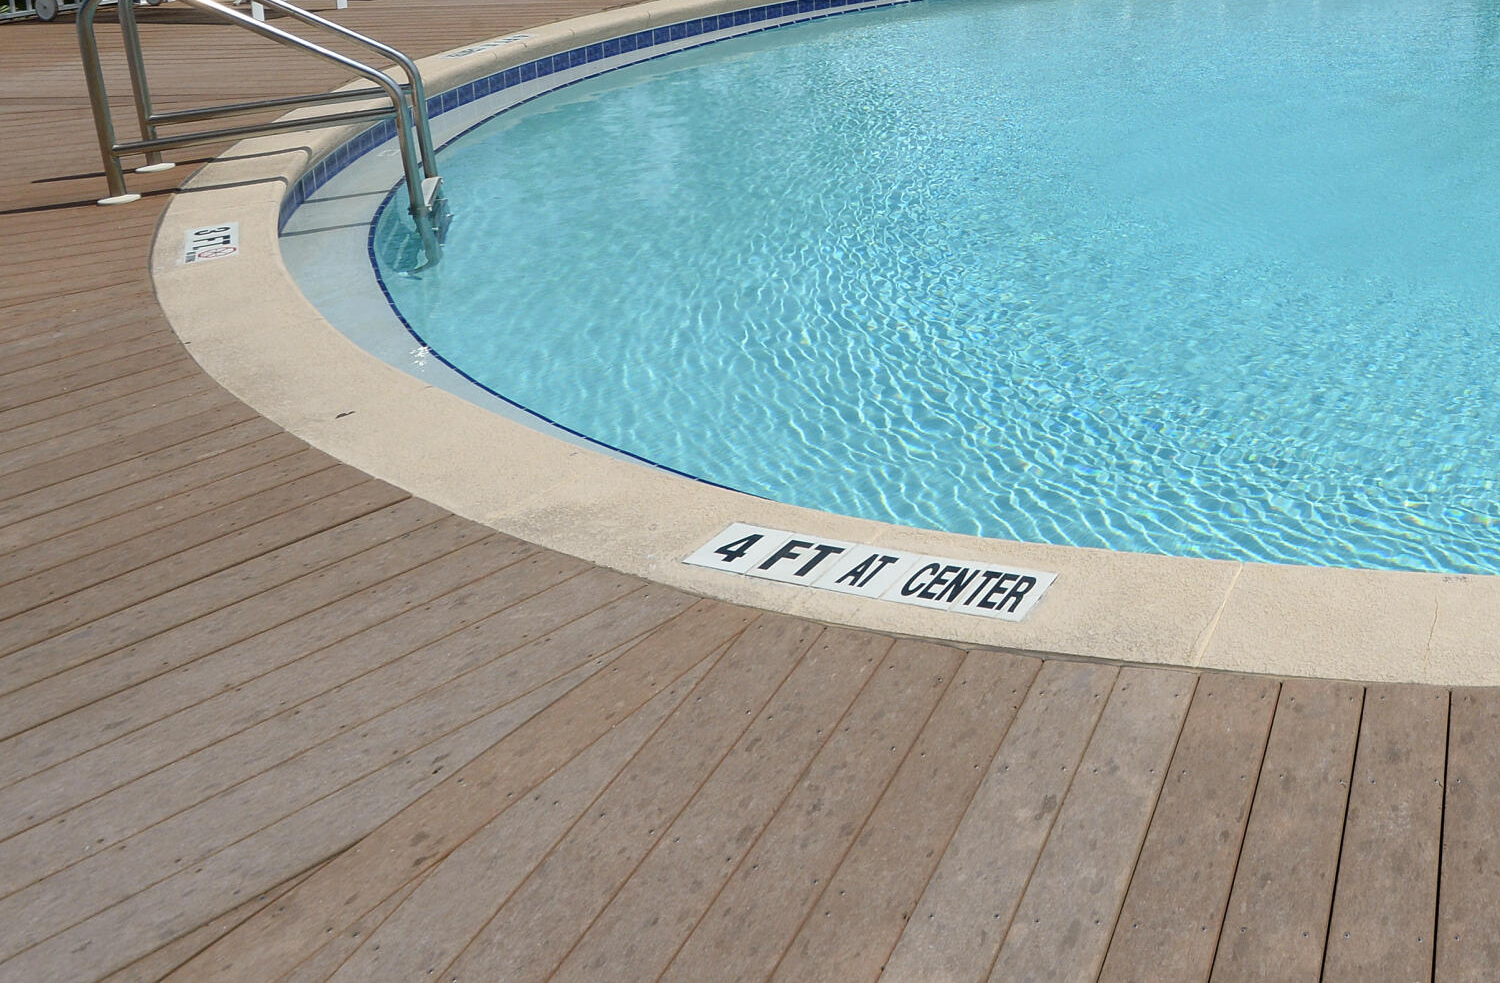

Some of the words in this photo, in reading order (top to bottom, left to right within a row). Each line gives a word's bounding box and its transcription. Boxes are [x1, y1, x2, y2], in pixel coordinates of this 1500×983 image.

[714, 533, 764, 562] 4
[757, 539, 844, 576] FT
[835, 553, 899, 587] AT
[900, 562, 1037, 613] CENTER
